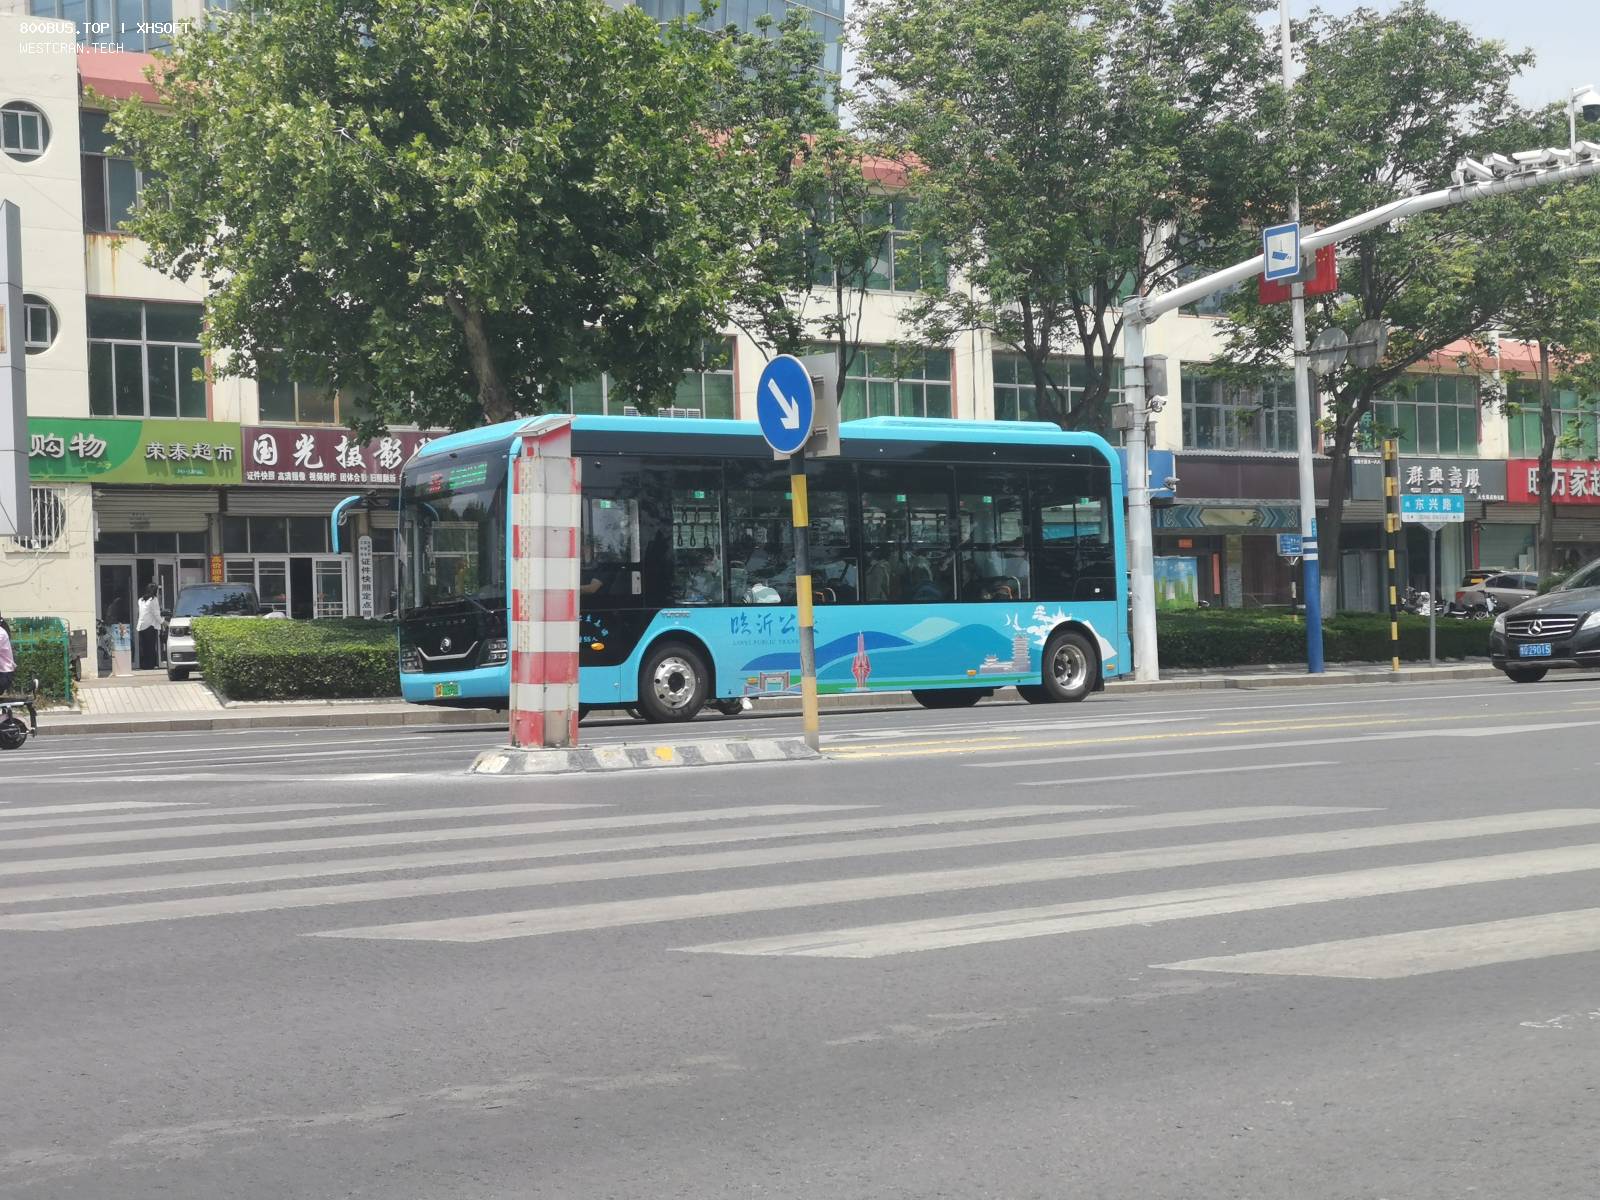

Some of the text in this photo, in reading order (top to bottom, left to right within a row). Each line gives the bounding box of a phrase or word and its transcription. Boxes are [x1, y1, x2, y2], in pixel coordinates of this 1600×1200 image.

[28, 432, 107, 459] 购物
[146, 440, 236, 462] 荣泰超市
